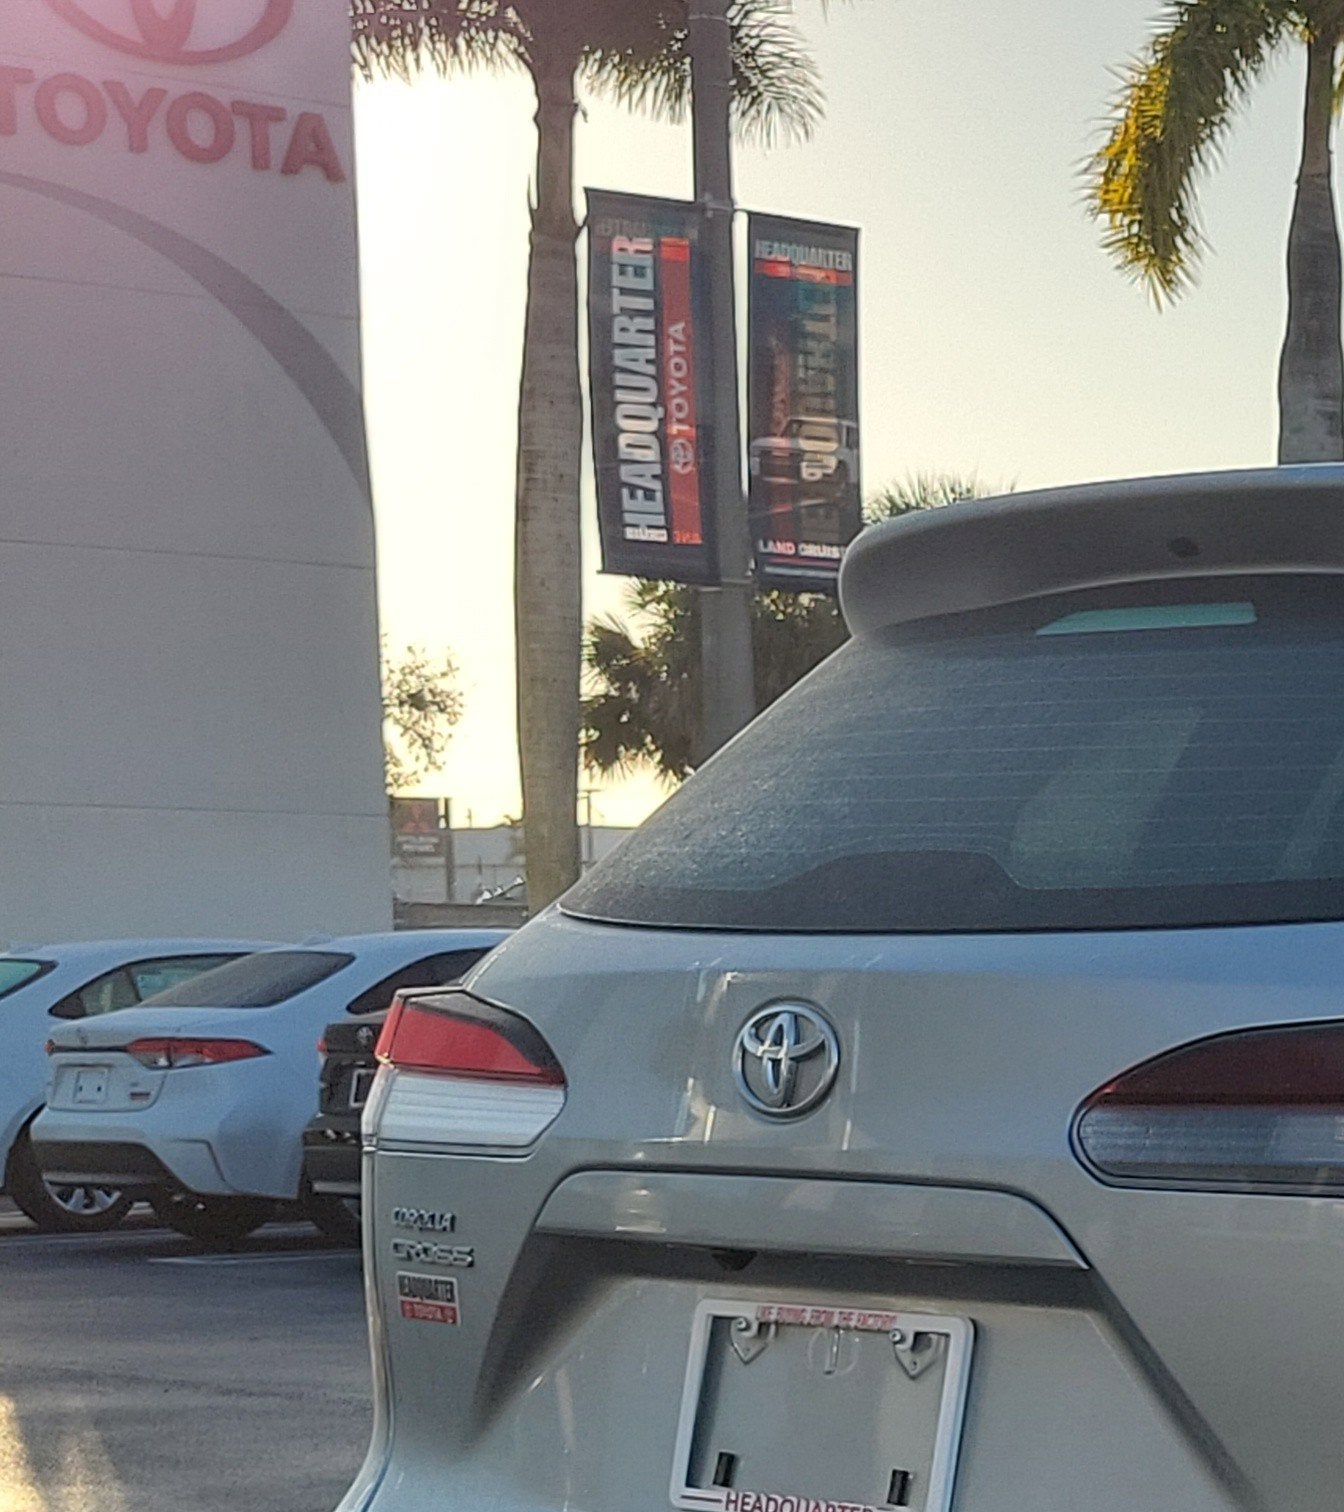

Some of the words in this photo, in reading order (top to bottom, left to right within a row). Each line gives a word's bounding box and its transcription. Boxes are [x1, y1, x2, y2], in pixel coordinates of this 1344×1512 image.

[0, 65, 346, 184] TOYOTA
[755, 239, 852, 272] HEADQUARTER
[611, 236, 668, 542] HEADQUARTER
[668, 321, 690, 433] TOYOTA
[759, 539, 796, 555] LAND
[798, 542, 847, 559] CRUIS
[392, 1239, 475, 1267] CROSS
